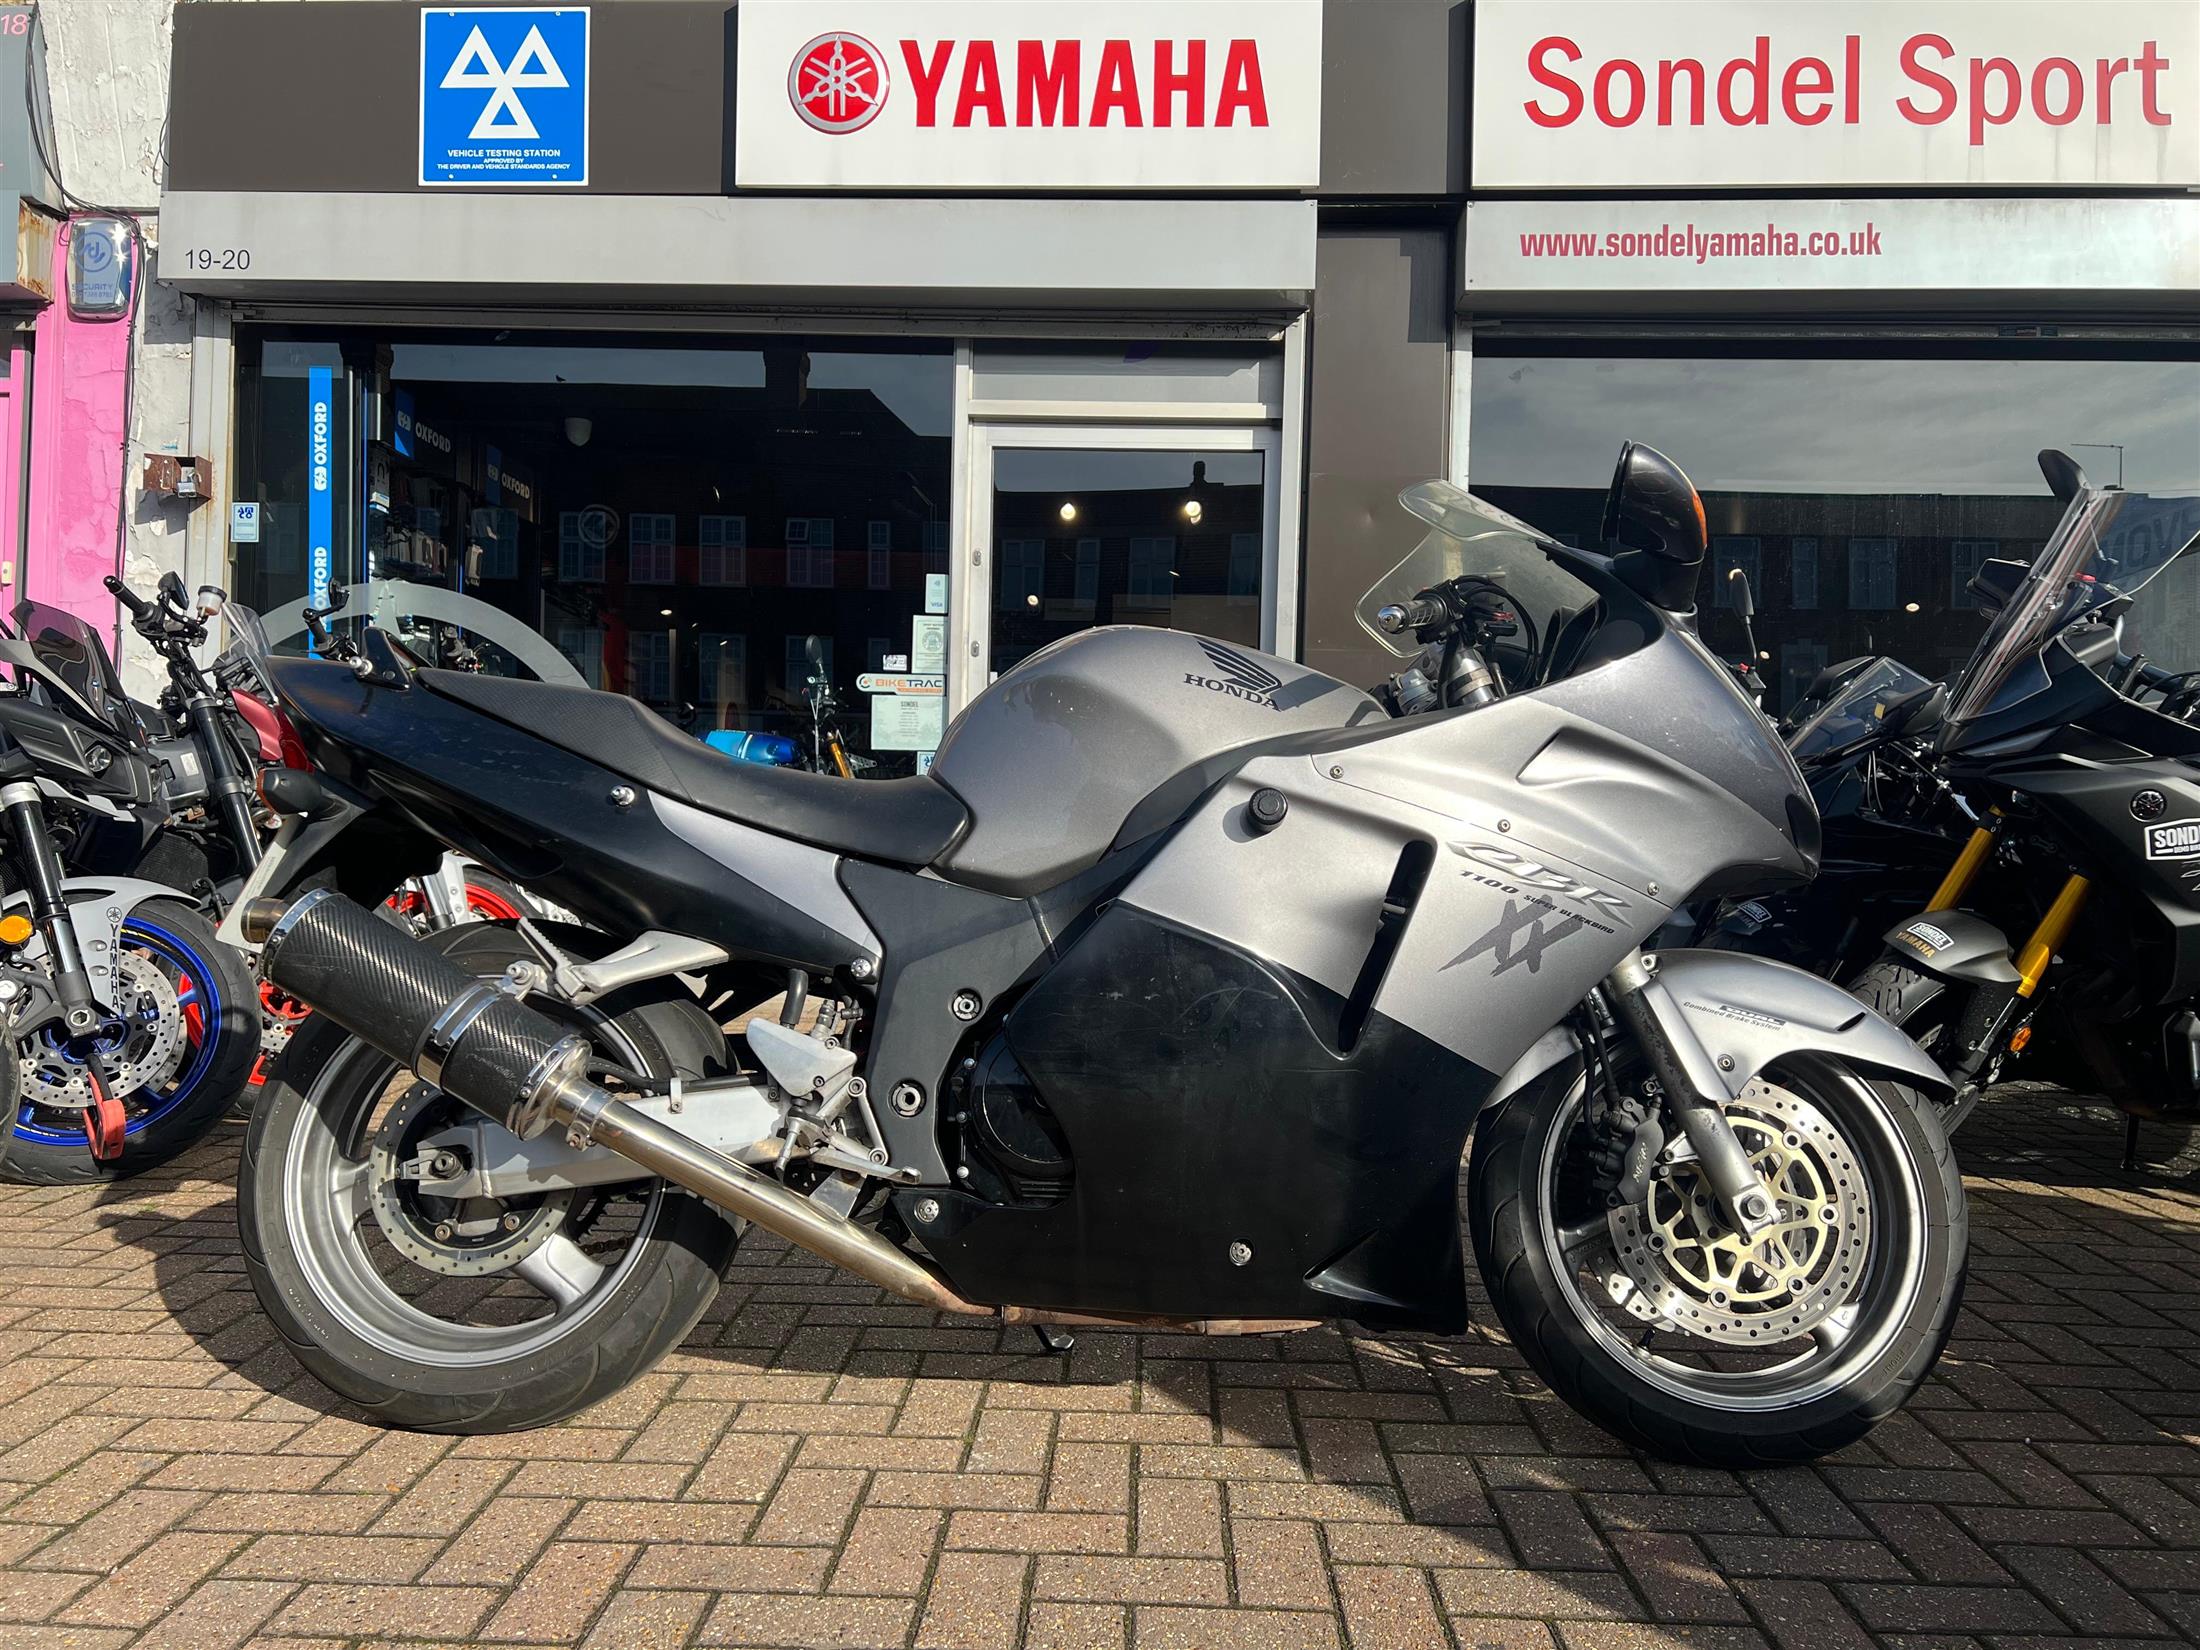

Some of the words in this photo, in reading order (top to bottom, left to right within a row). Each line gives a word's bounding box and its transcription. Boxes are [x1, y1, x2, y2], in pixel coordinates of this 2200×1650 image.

[0, 14, 28, 35] 18
[899, 39, 1270, 127] YAMAHA
[1523, 35, 1861, 128] Sondel
[1896, 33, 2172, 146] Sport
[447, 149, 484, 157] VEHICLE
[486, 149, 522, 157] TESTING
[523, 149, 561, 157] STATION
[185, 248, 251, 270] 19-20
[1519, 222, 1882, 265] www.sondelyamaha.co.uk
[313, 401, 328, 465] OXFORD
[414, 421, 452, 453] OXFORD
[501, 472, 531, 500] OXFORD
[313, 546, 328, 610] OXFORD
[874, 678, 943, 688] BIKETRAC
[1183, 672, 1282, 712] HONDA
[2153, 824, 2200, 848] SOND
[1459, 869, 1520, 895] 1100
[1523, 893, 1559, 912] SUPER
[1559, 908, 1616, 935] BLACKBIRD
[1895, 931, 1936, 958] YAMAHA
[109, 923, 120, 1009] YAMAHA
[1683, 1001, 1725, 1017] Combined
[1726, 1012, 1751, 1024] Brake
[1751, 1018, 1782, 1032] System
